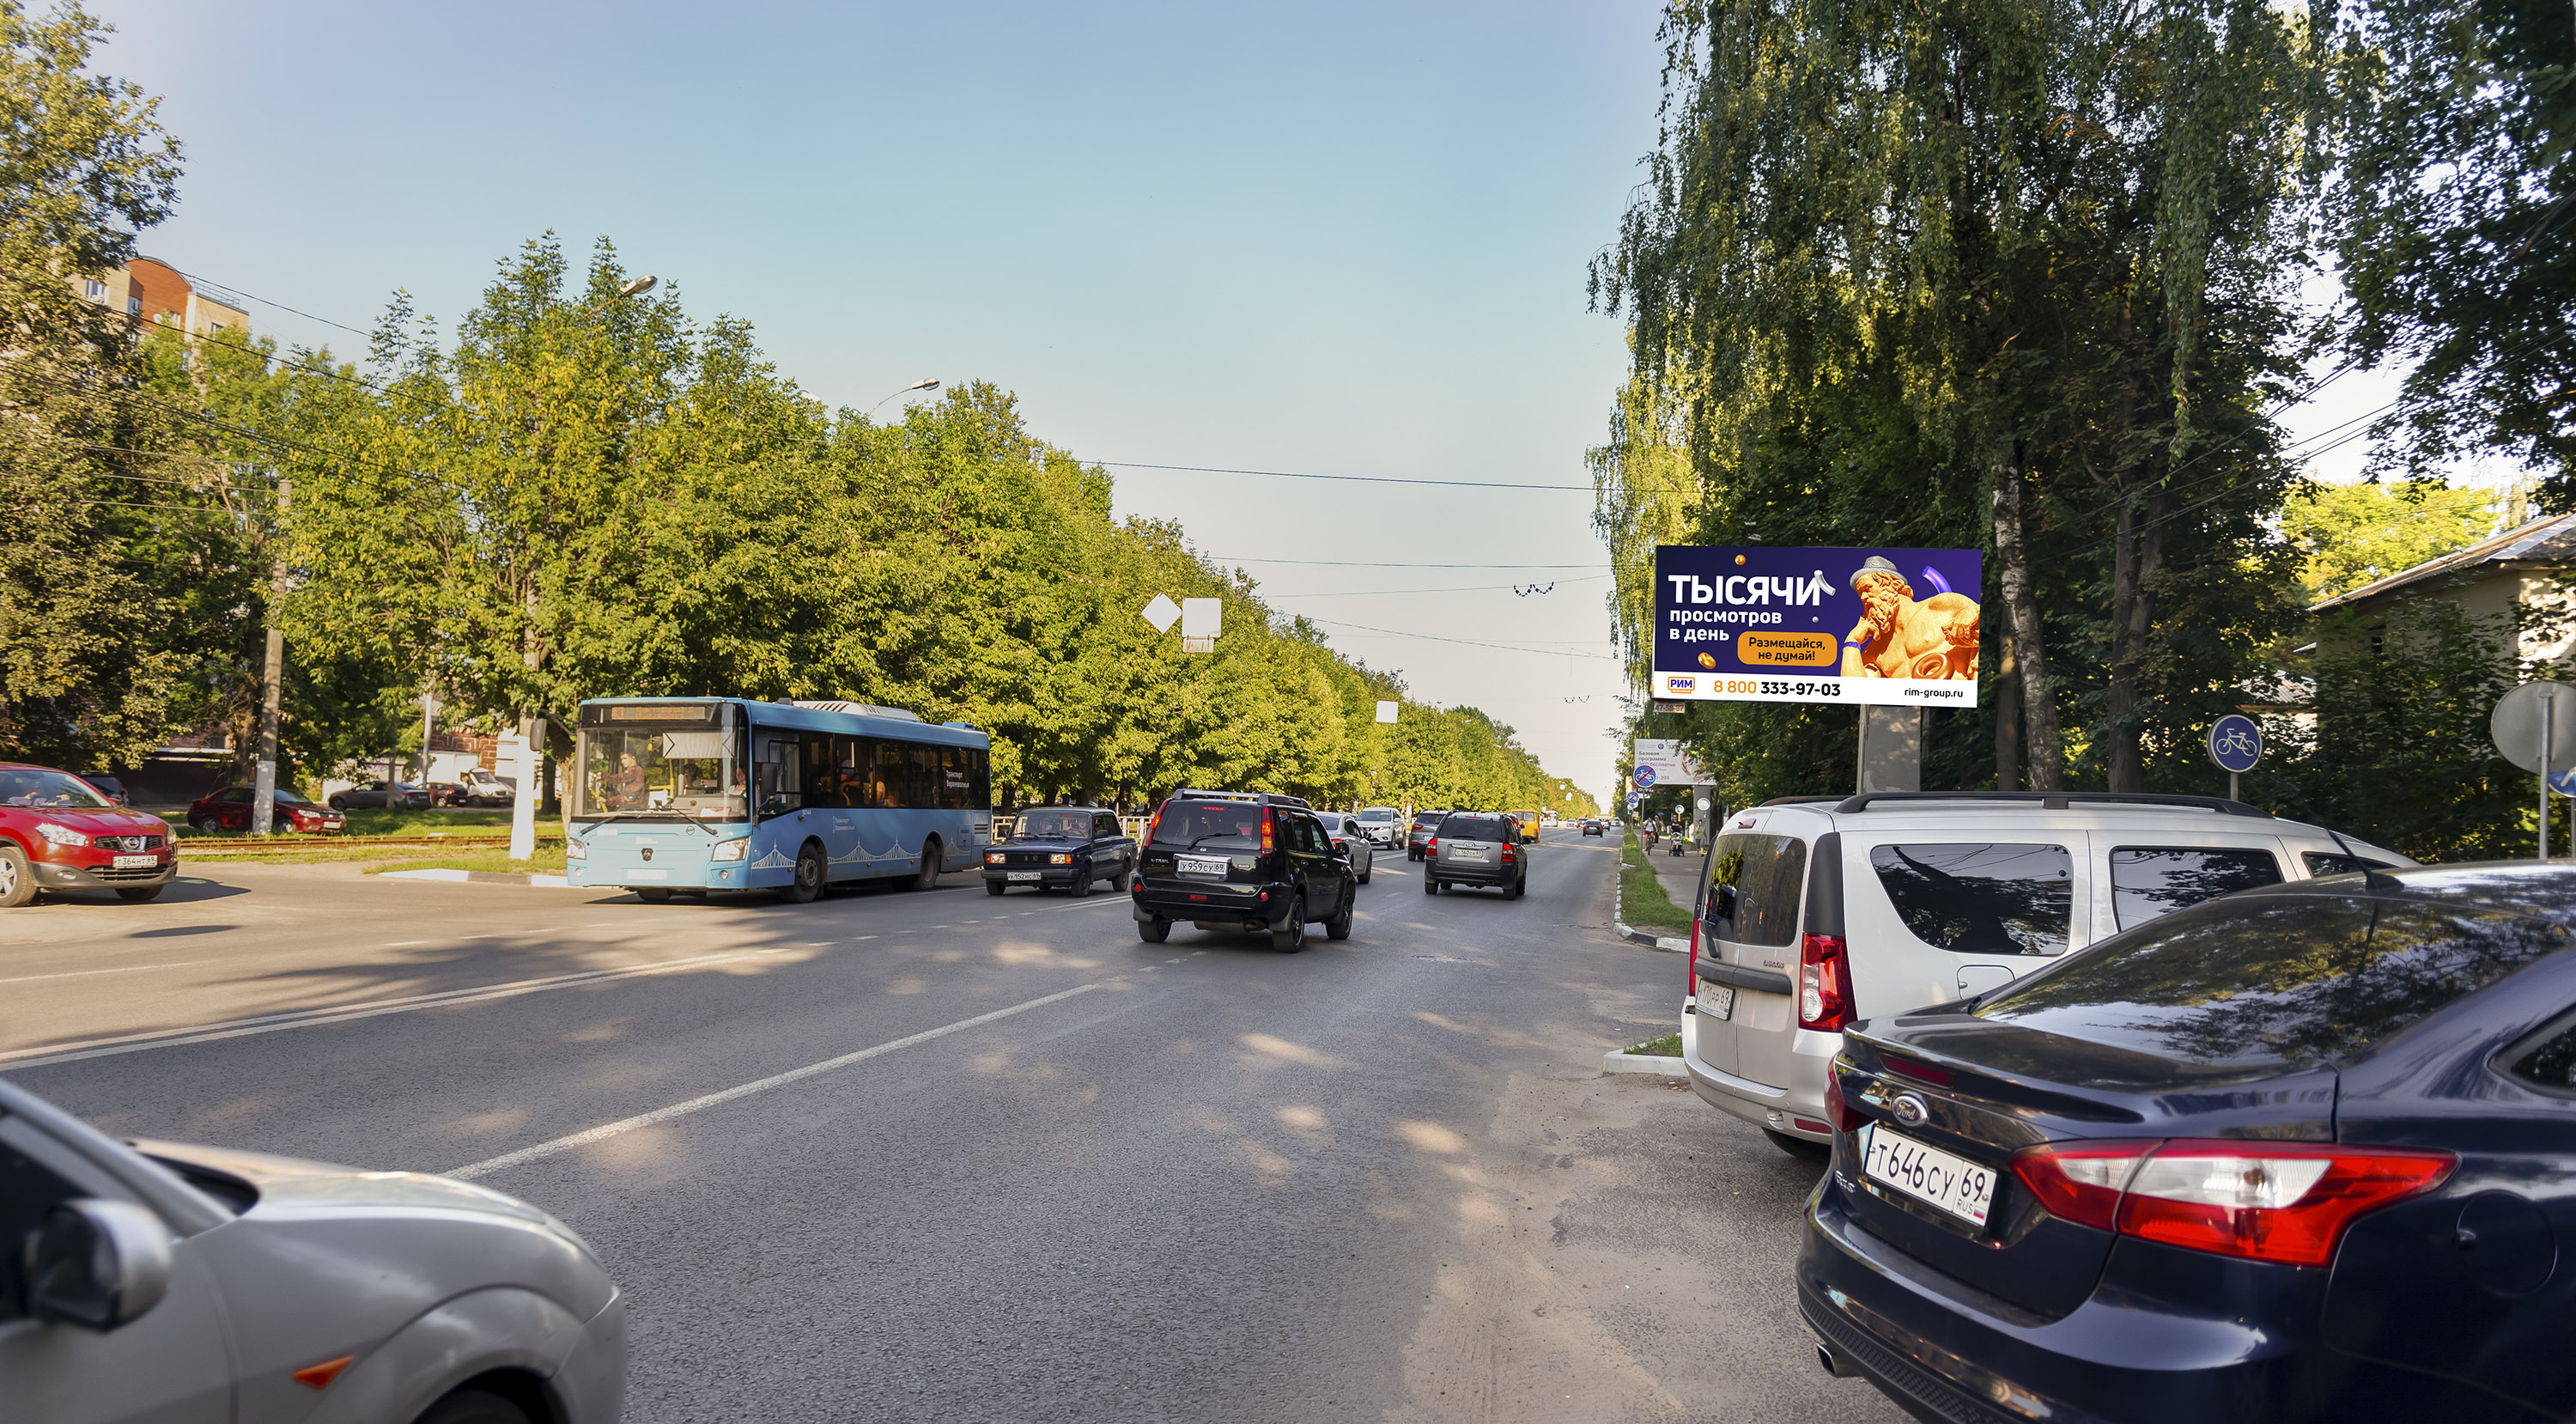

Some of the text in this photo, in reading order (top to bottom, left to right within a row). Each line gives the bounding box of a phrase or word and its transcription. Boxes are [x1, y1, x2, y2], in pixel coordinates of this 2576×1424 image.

[1668, 575, 1820, 606] ТЫСЯЧИ
[1669, 610, 1783, 627] просмотров
[1669, 629, 1730, 642] в день
[1748, 636, 1826, 650] Размещайся,
[1758, 651, 1815, 662] не думай!
[1670, 679, 1692, 688] РИМ
[1714, 680, 1841, 697] 8 800 333-97-03
[1905, 688, 1963, 698] rim-group.ru
[1182, 861, 1213, 871] У959СУ
[1896, 1100, 1917, 1120] Ford
[1877, 1141, 1986, 1202] Т646СУ 69
[1957, 1198, 1973, 1214] RUS
